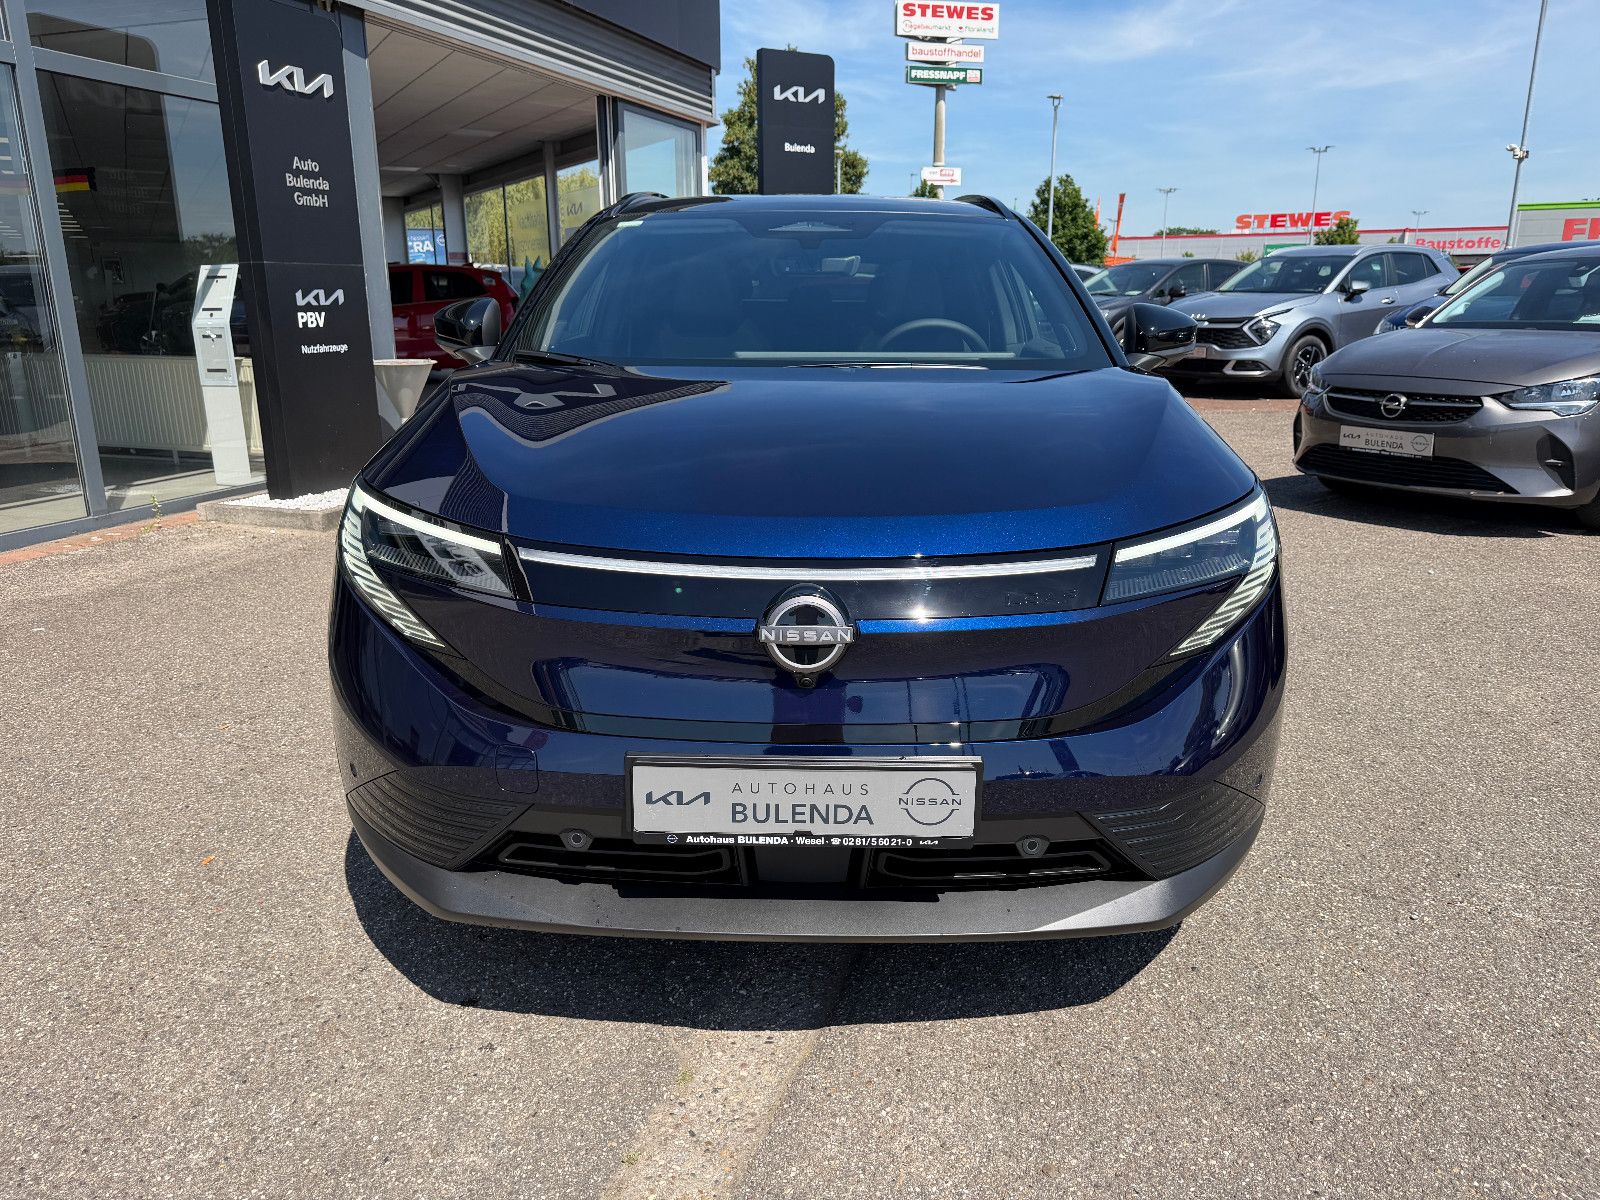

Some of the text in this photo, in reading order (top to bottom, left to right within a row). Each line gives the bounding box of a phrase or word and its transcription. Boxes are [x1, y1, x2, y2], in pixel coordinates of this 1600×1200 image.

[903, 3, 994, 20] STEWES
[911, 46, 981, 57] baustoffhandel
[257, 59, 334, 99] KIA
[911, 69, 966, 80] FRESSNAPF
[773, 84, 826, 104] KIA
[784, 142, 815, 153] Bulenda
[293, 156, 319, 172] Auto
[285, 172, 330, 190] Bulenda
[293, 191, 329, 208] GmbH
[295, 288, 345, 306] KIA
[297, 311, 326, 328] PBV
[301, 344, 349, 354] Nutzfahrzeuge
[1364, 438, 1404, 450] BULENDA
[760, 628, 851, 642] NISSAN
[731, 782, 869, 796] AUTOHAUS
[645, 790, 711, 806] KIA
[898, 797, 962, 806] NISSAN
[731, 802, 874, 825] BULENDA
[686, 835, 735, 844] Autohaus
[737, 836, 789, 845] BULENDA
[795, 837, 825, 845] Wesel
